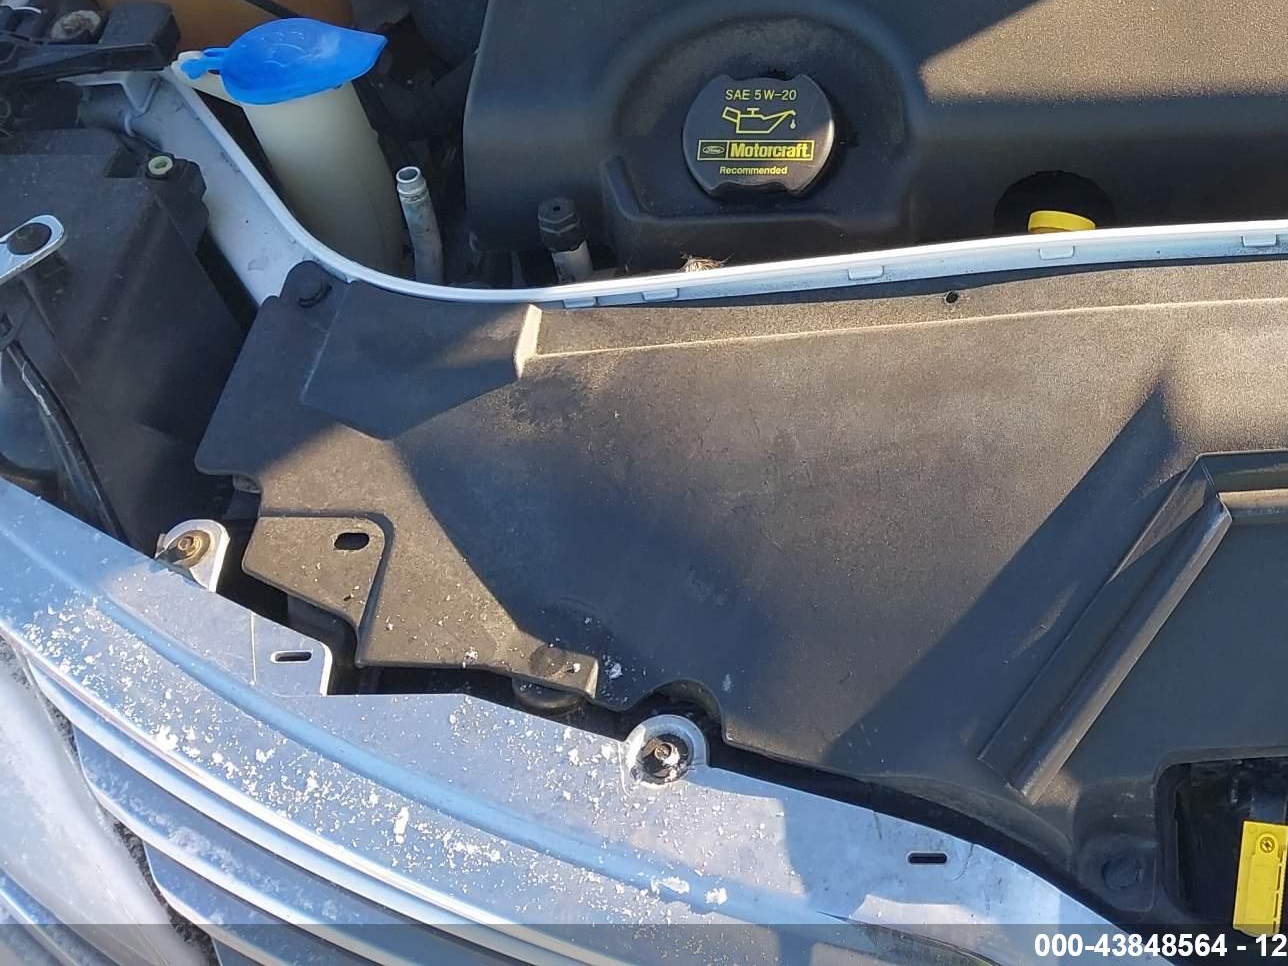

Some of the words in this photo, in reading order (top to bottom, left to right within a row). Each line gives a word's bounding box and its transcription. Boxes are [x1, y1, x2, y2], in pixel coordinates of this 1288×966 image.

[725, 89, 751, 101] SAE
[754, 89, 797, 101] 5W-20
[719, 165, 789, 176] Recommended
